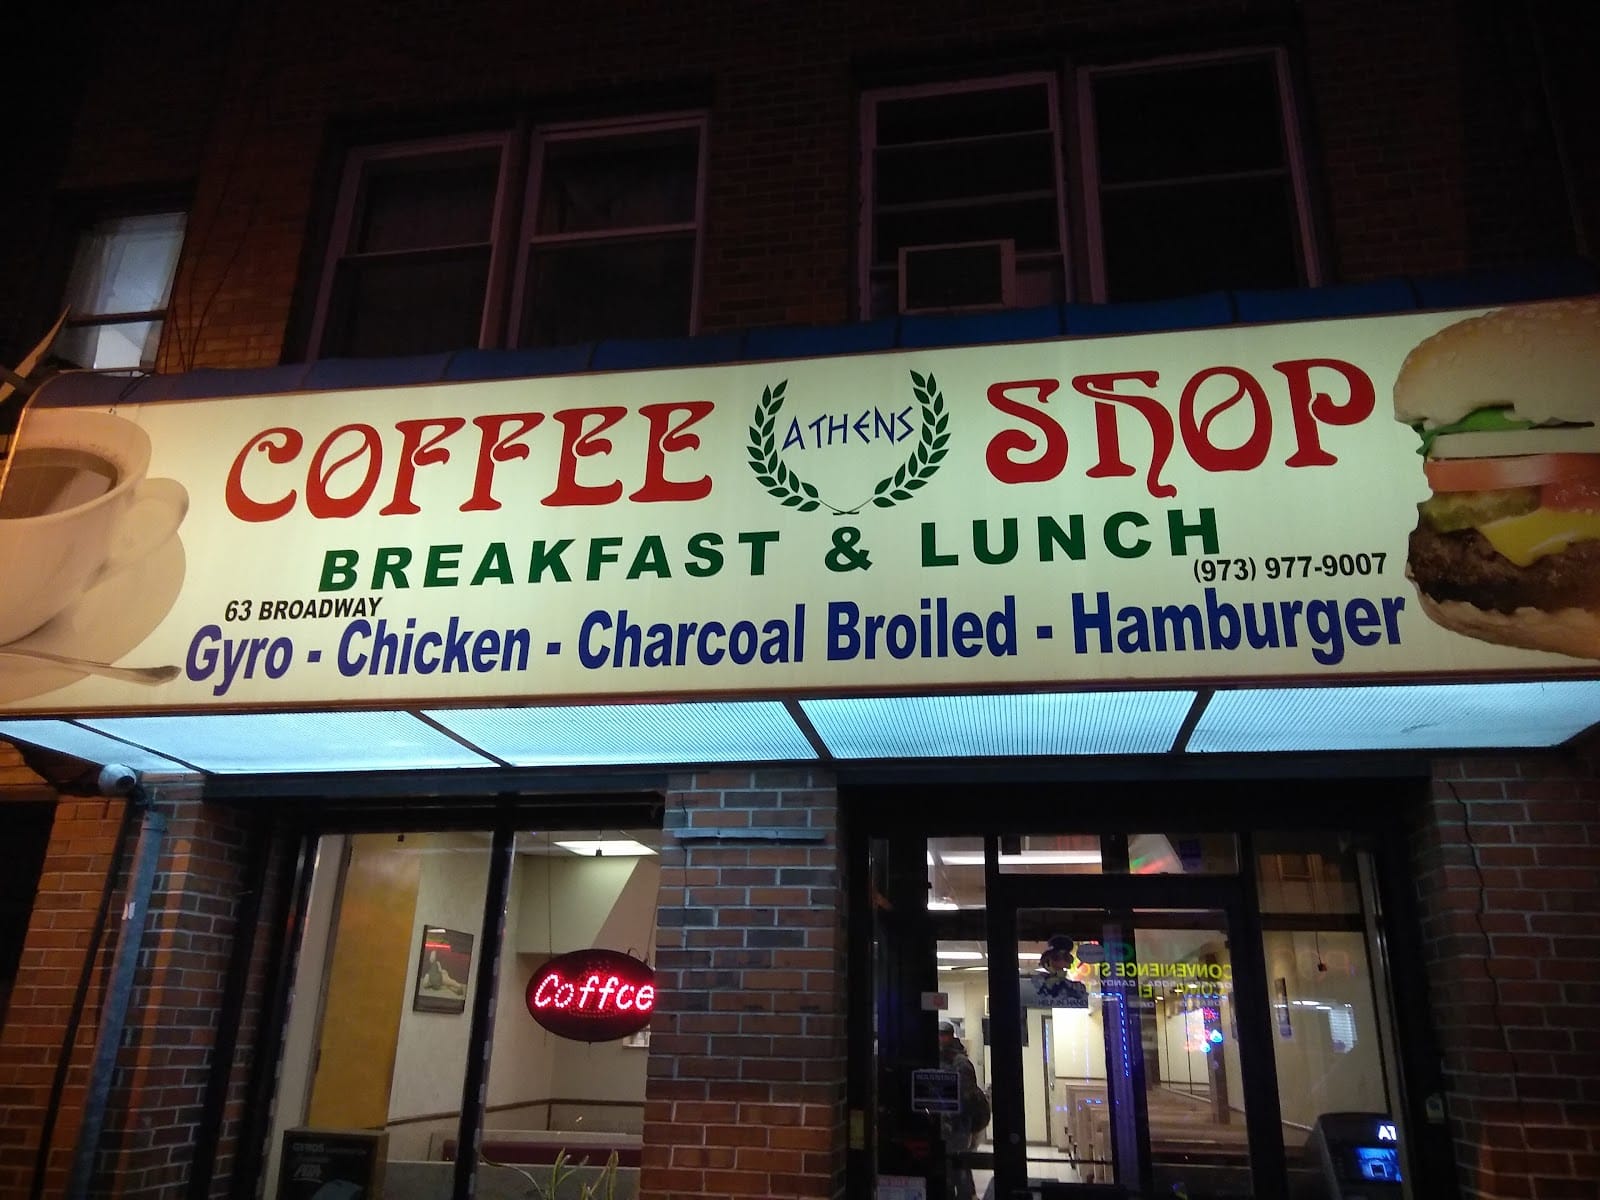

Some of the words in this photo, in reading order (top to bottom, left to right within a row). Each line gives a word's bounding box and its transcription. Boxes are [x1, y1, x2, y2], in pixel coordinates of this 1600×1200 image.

[224, 400, 713, 523] COFFEE
[985, 358, 1376, 499] SHOP
[783, 405, 915, 452] ATHENS
[318, 531, 781, 592] BREAKFAST
[824, 526, 872, 573] &
[920, 507, 1221, 567] LUNCH
[1193, 556, 1257, 583] (973)
[1264, 552, 1388, 580] 977-9007
[223, 600, 253, 622] 63
[258, 597, 382, 621] BROADWAY
[185, 624, 293, 696] Gyro
[337, 616, 531, 677] Chicken
[578, 603, 805, 669] Charcoal
[827, 595, 1017, 661] Broiled
[1072, 587, 1405, 665] Hamburger
[1378, 1124, 1397, 1141] AT
